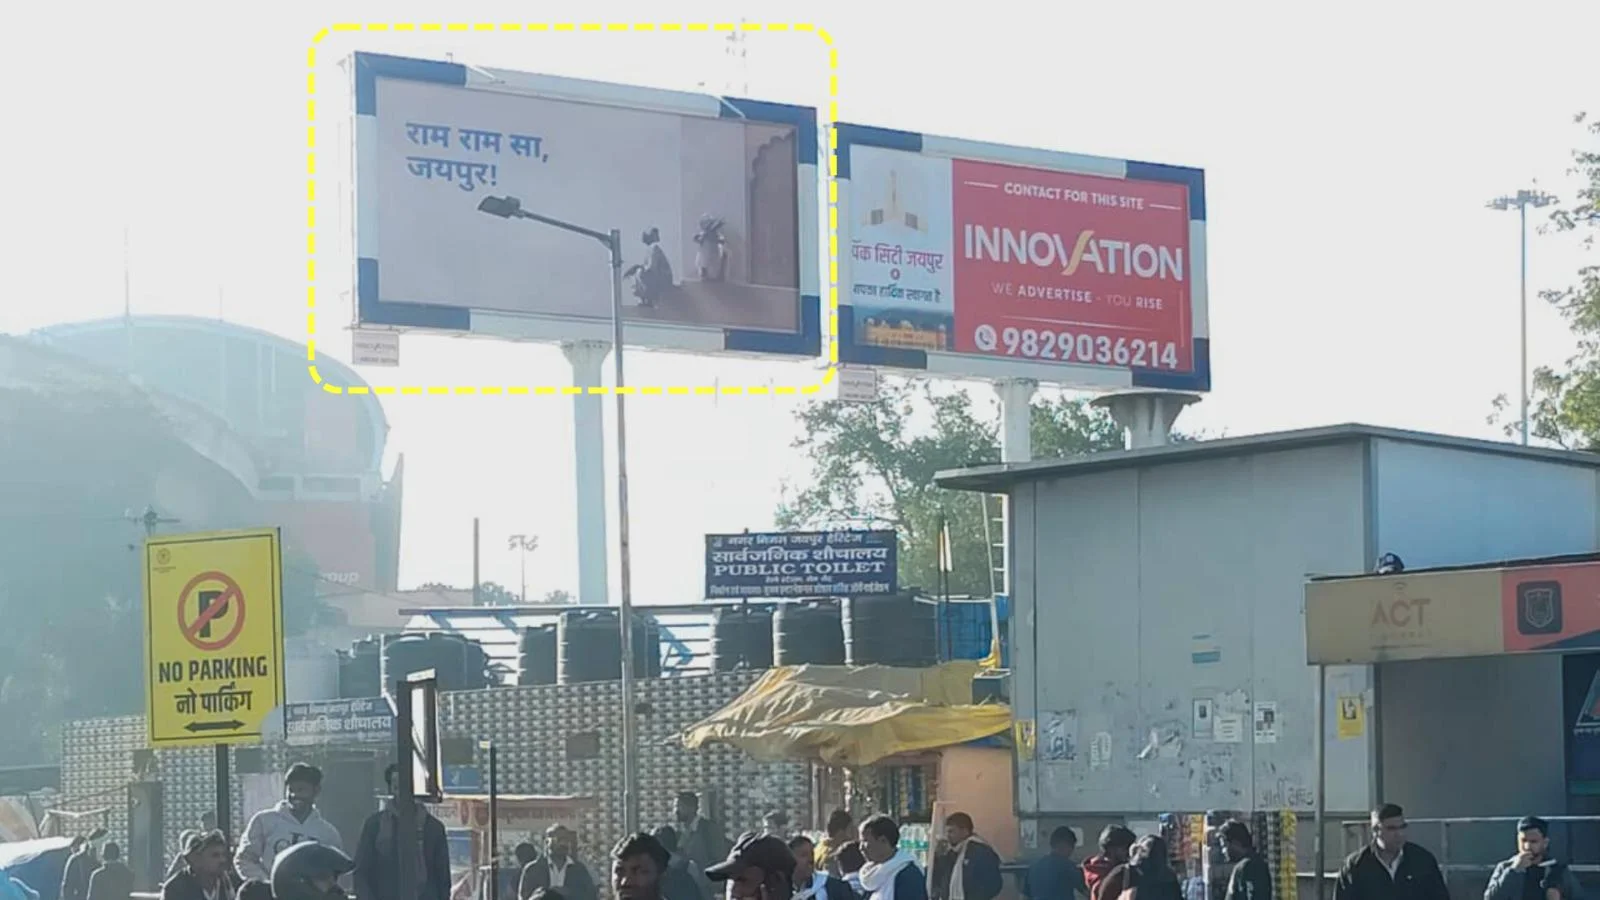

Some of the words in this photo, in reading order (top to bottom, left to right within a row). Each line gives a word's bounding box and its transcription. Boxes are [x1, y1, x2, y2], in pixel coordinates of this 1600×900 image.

[405, 123, 450, 148] राम
[458, 128, 502, 154] राम
[509, 134, 548, 163] सा,
[405, 156, 497, 191] जयपुर!
[1004, 182, 1061, 201] CONTACT
[1063, 188, 1089, 203] FOR
[1091, 191, 1118, 208] THIS
[1119, 194, 1145, 211] SITE
[874, 243, 903, 265] सिटी
[905, 249, 944, 274] जयपुर
[963, 223, 1183, 282] INNOVATION
[990, 281, 1013, 296] WE
[1017, 284, 1092, 304] ADVERTISE
[1106, 294, 1132, 308] YOU
[1136, 297, 1162, 311] RISE
[1003, 328, 1178, 369] 9829036214
[714, 562, 797, 577] PUBLIC
[800, 561, 886, 576] TOILET
[1371, 598, 1432, 628] ACT
[158, 661, 183, 684] NO
[189, 656, 268, 682] PARKING
[174, 688, 198, 715] नो
[200, 681, 253, 713] पार्किंग
